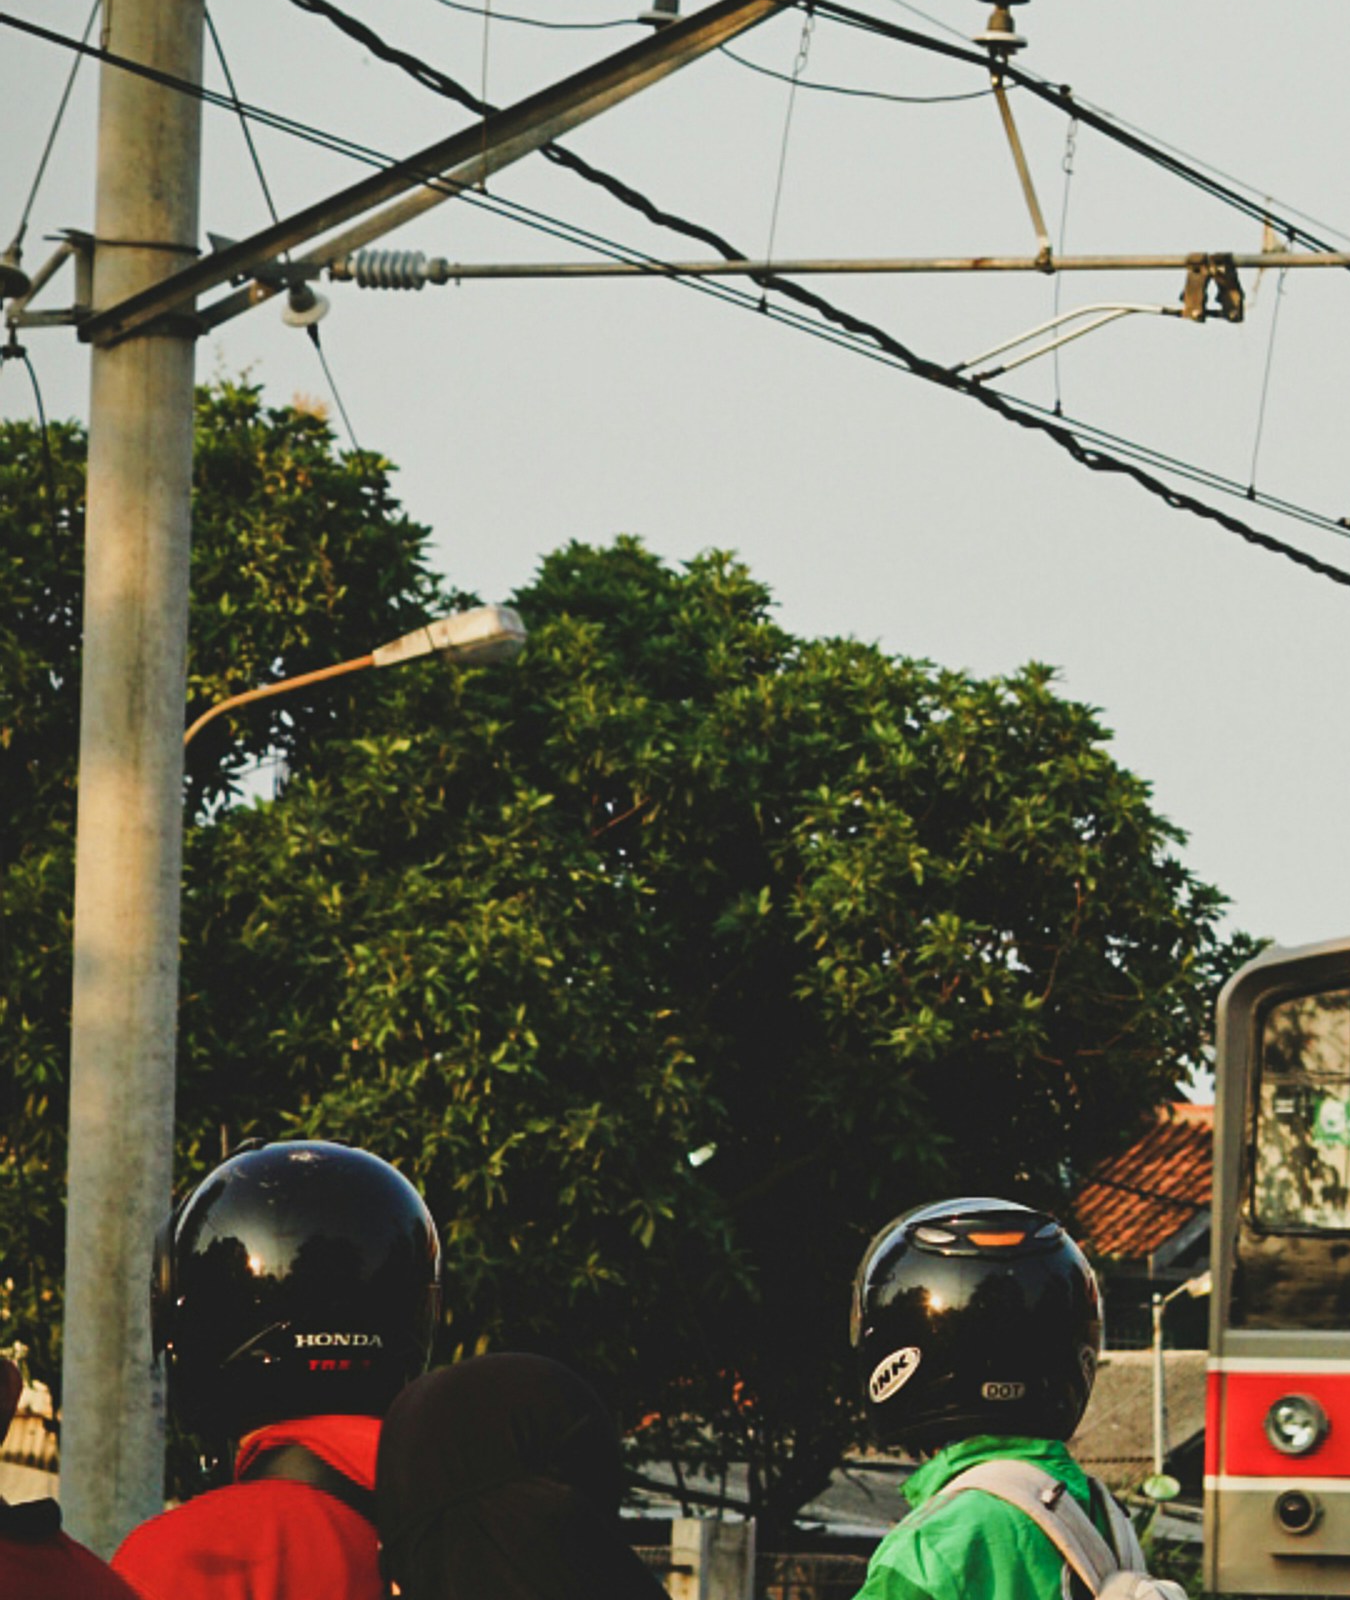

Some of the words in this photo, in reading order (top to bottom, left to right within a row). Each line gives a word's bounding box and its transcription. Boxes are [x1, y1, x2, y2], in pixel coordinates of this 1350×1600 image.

[294, 1332, 383, 1348] HONDA
[871, 1354, 909, 1396] INK
[986, 1384, 1022, 1399] DOT
